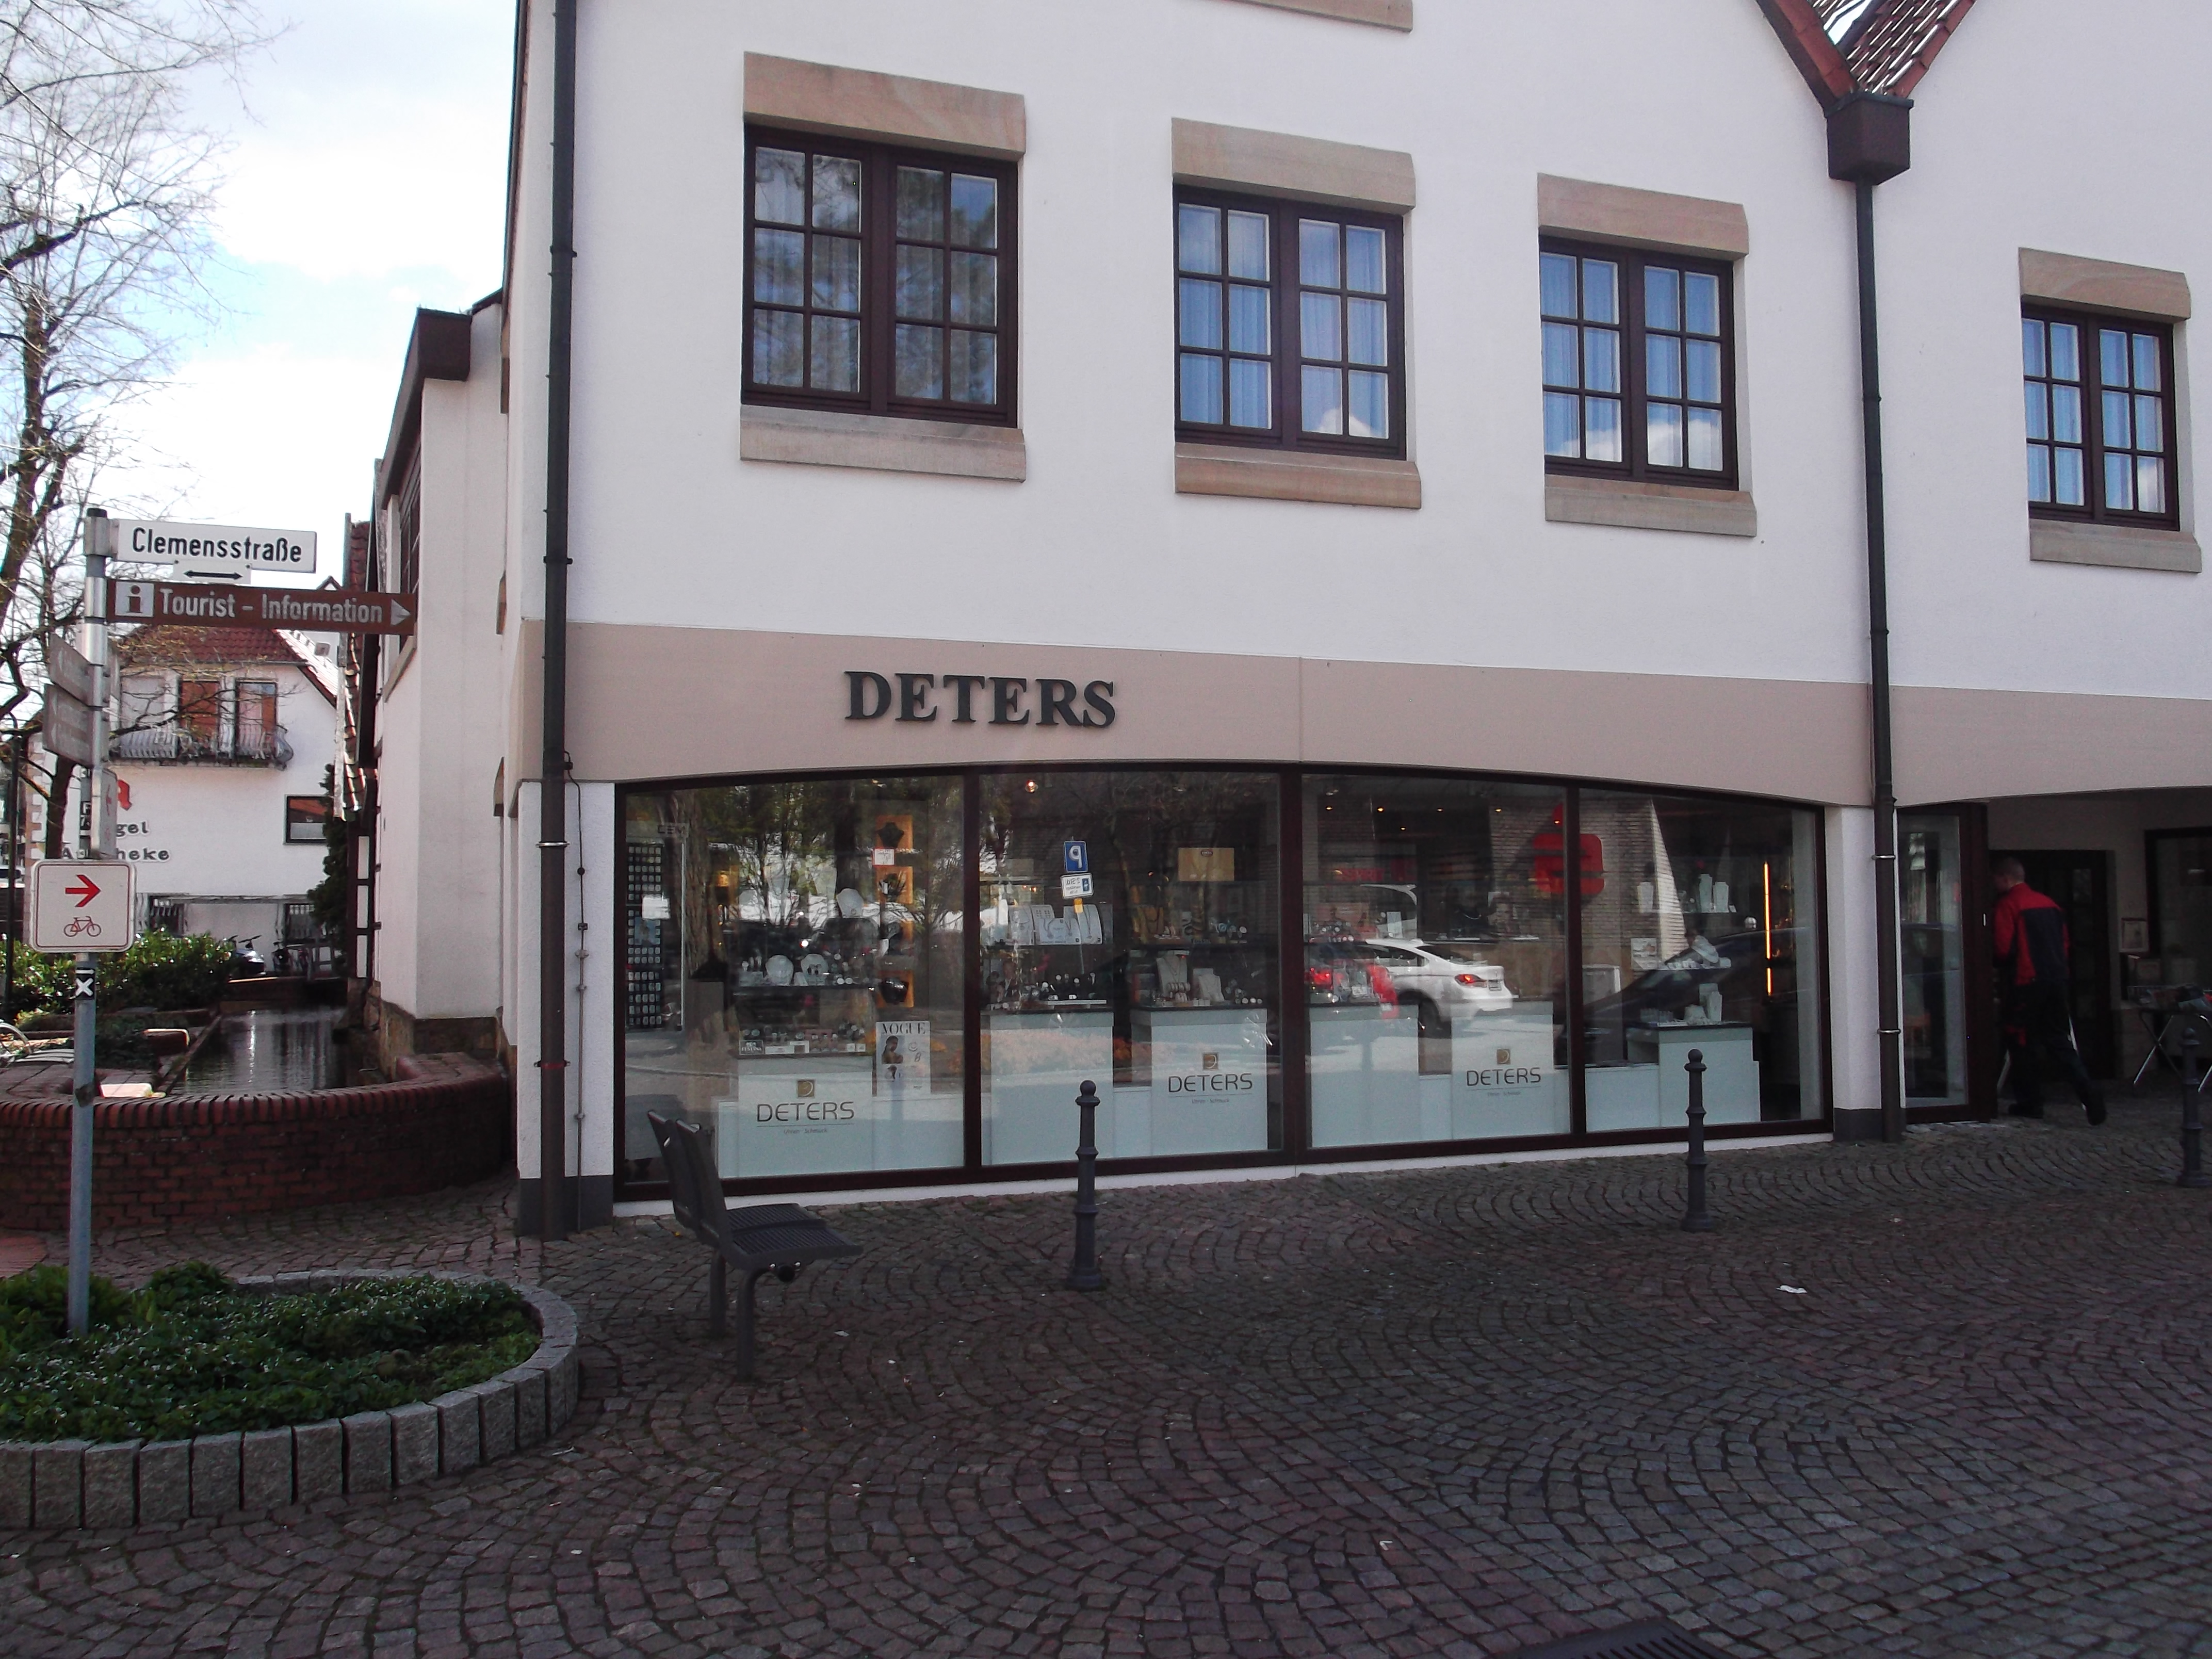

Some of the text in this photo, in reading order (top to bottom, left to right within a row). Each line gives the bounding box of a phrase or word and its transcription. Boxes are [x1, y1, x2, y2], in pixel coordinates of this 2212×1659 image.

[132, 527, 302, 563] Clemensstraße
[159, 588, 235, 618] Tourist
[262, 593, 382, 623] Information
[844, 671, 1116, 728] DETERS
[882, 1022, 925, 1034] VOGUE
[1168, 1073, 1253, 1093] DETERS
[1467, 1067, 1541, 1086] DETERS
[757, 1101, 855, 1122] DETERS
